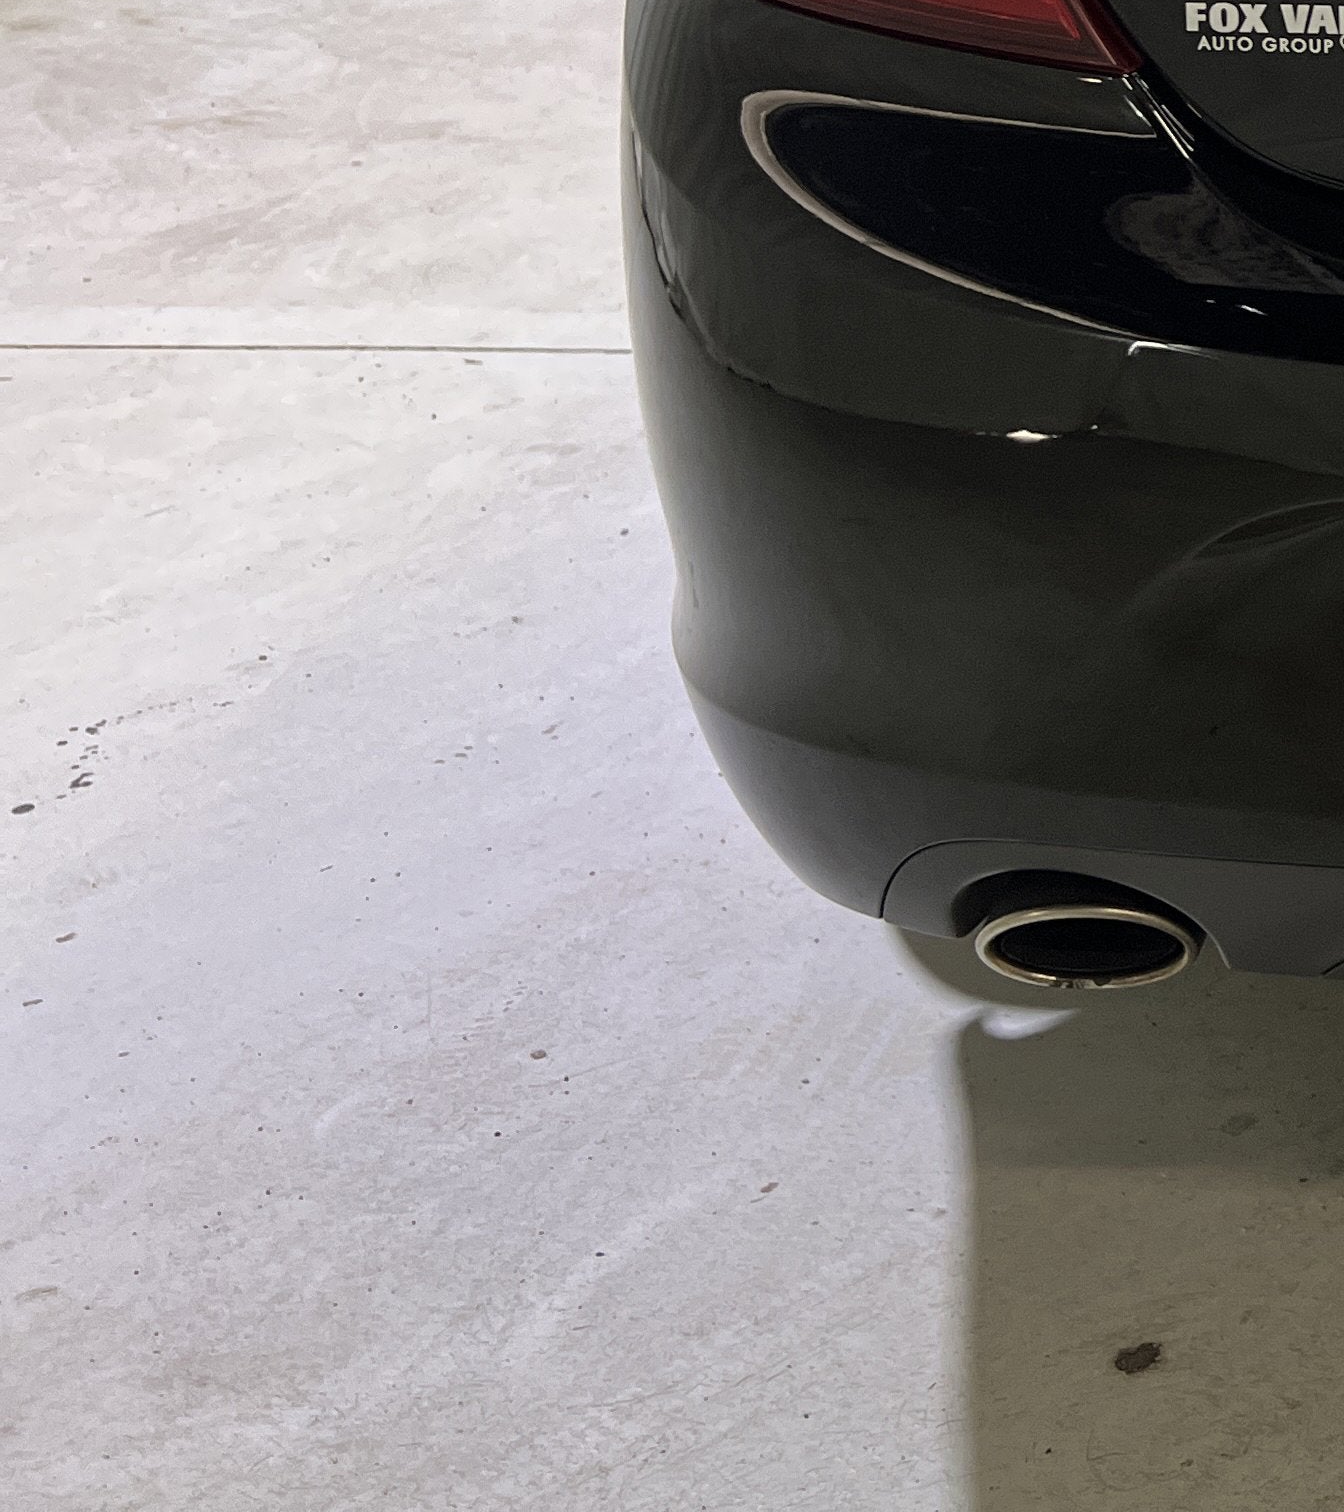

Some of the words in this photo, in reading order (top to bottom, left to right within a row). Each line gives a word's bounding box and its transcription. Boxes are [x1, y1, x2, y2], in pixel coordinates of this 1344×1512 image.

[1184, 1, 1269, 34] FOX
[1197, 35, 1253, 52] AUTO
[1261, 37, 1335, 54] GROUP
